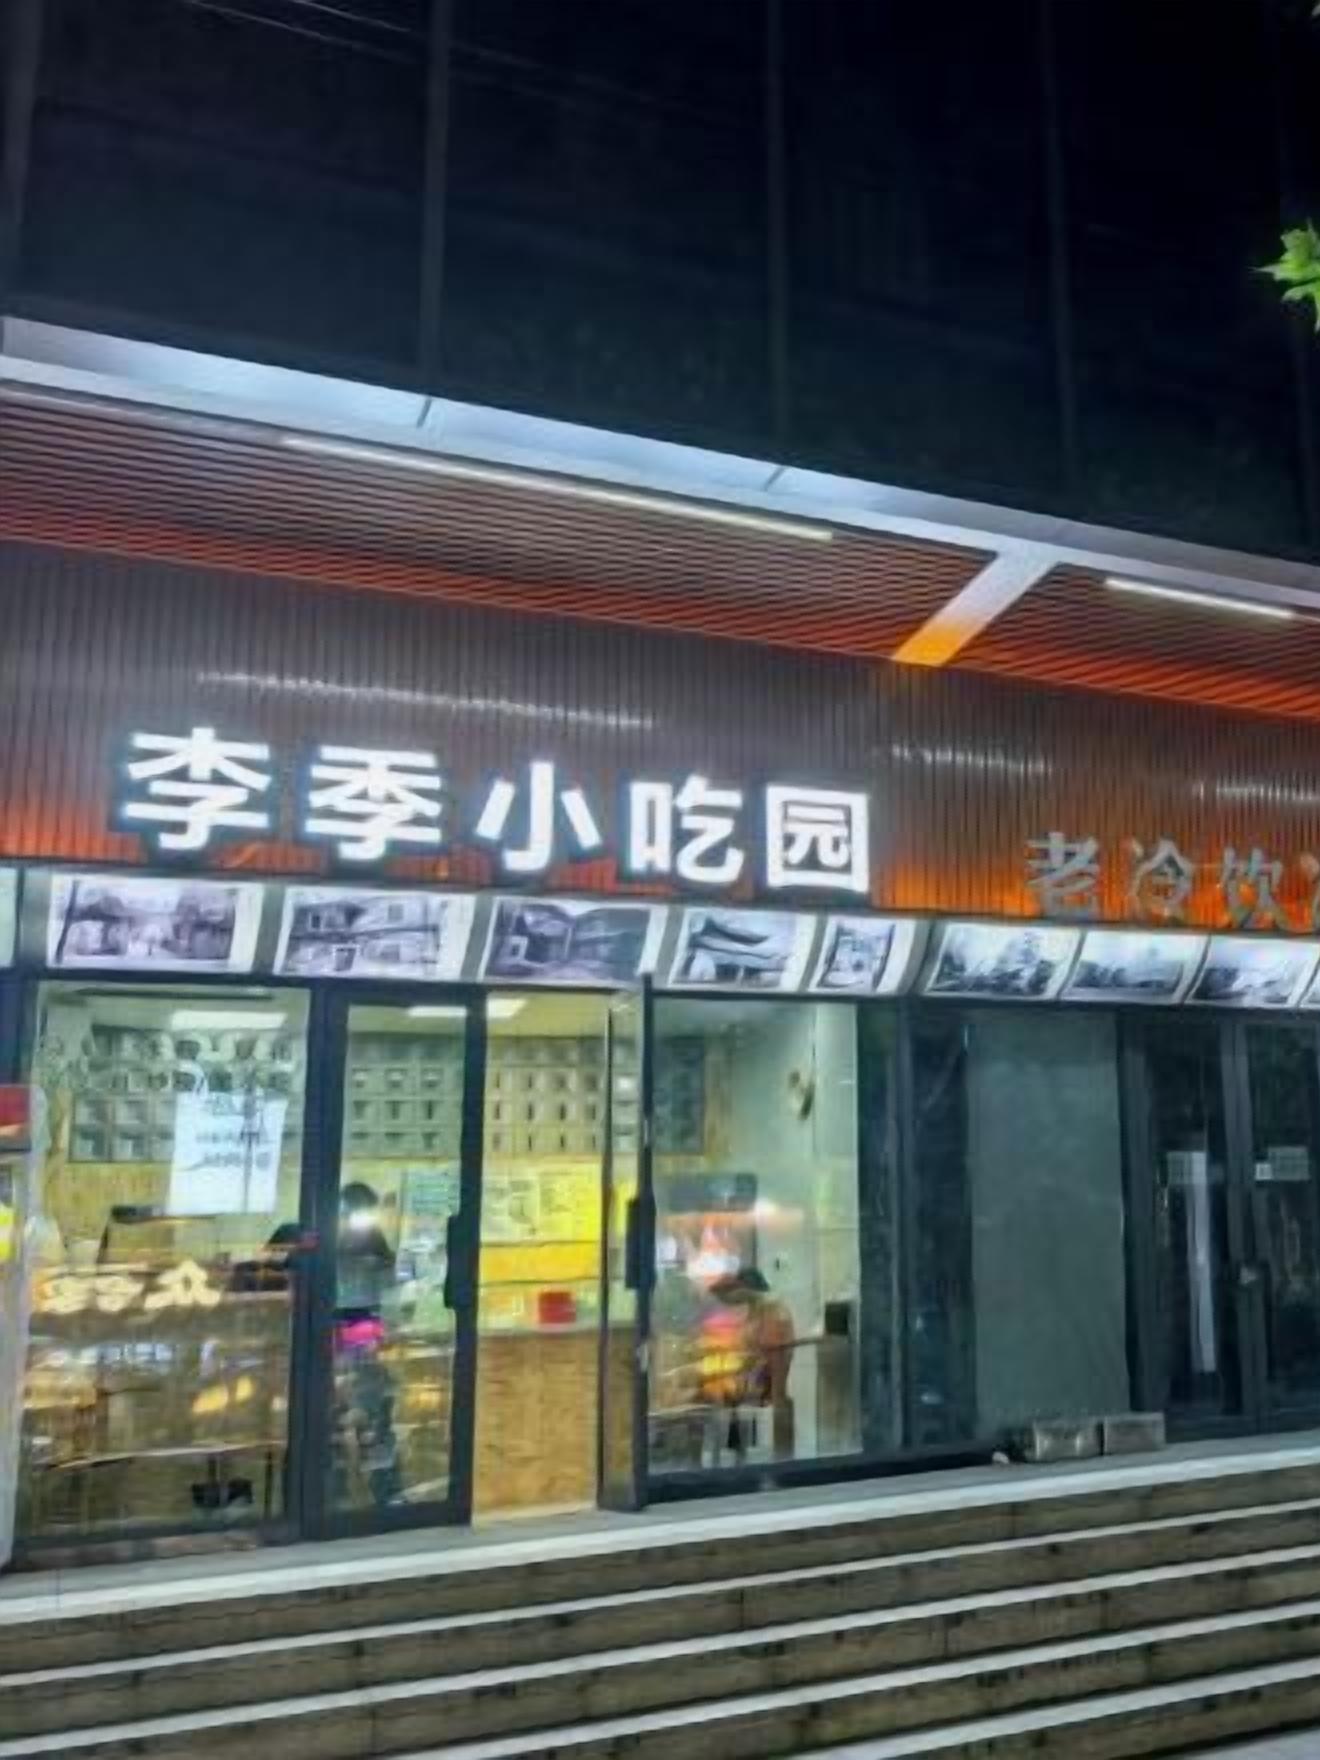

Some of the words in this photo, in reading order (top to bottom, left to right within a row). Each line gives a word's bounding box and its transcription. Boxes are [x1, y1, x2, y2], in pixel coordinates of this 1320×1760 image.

[121, 725, 873, 895] 李季小吃园
